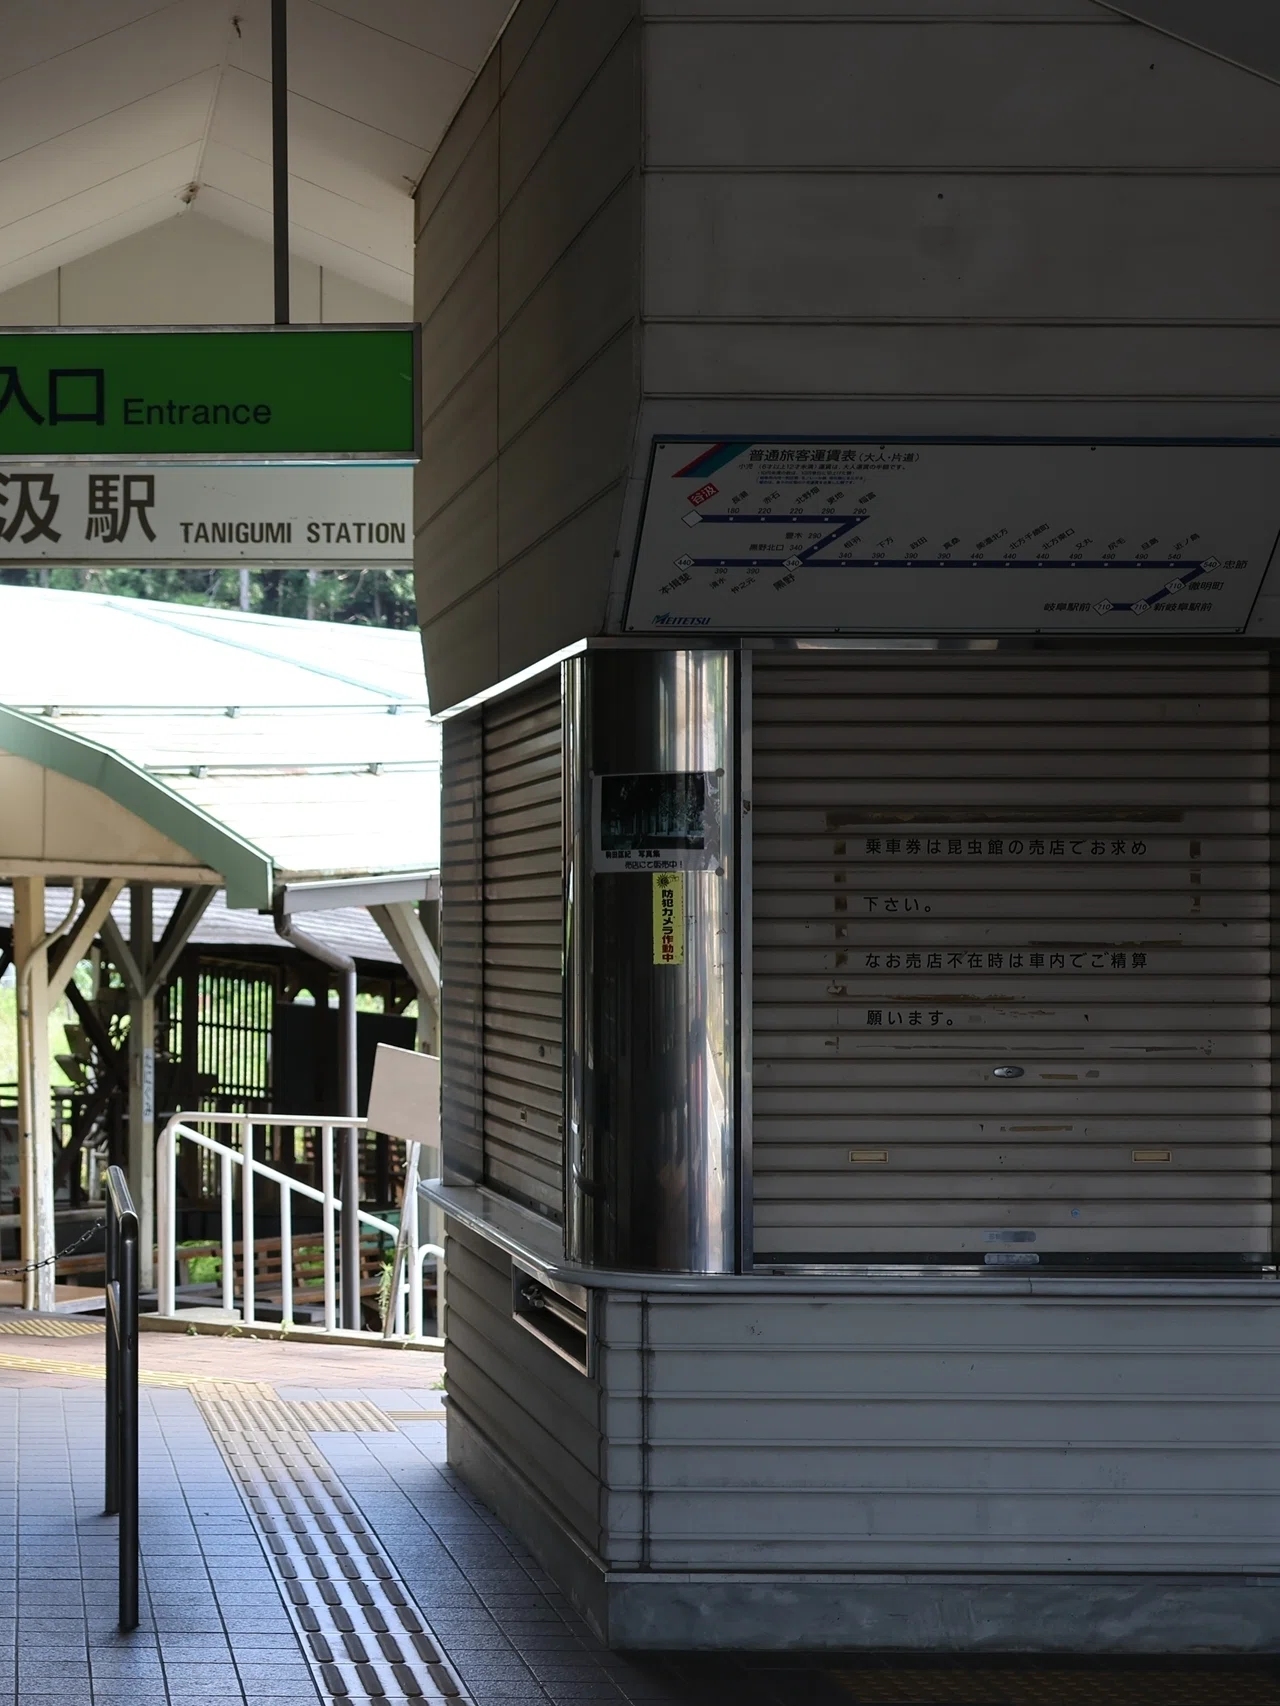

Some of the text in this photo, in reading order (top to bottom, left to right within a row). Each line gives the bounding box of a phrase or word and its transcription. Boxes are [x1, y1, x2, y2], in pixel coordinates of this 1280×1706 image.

[123, 398, 272, 426] Entrance
[691, 485, 716, 504] 谷汲
[180, 521, 406, 545] TANIGUMI STATION
[749, 544, 784, 552] 黒野北口
[876, 537, 894, 549] 下方
[1223, 560, 1248, 569] 忠節
[773, 573, 796, 592] 黒野
[1044, 602, 1091, 612] 岐阜駅前
[1153, 602, 1213, 612] 新岐阜駅前
[652, 612, 711, 625] MEITETSU
[865, 838, 1148, 856] 乗車券は昆虫館の売店でお求め
[864, 896, 933, 914] 下さい。
[661, 889, 675, 962] 防犯カメラ作動中
[865, 951, 1149, 969] なお売店不在時は車内でご精算
[866, 1009, 955, 1027] 願います。
